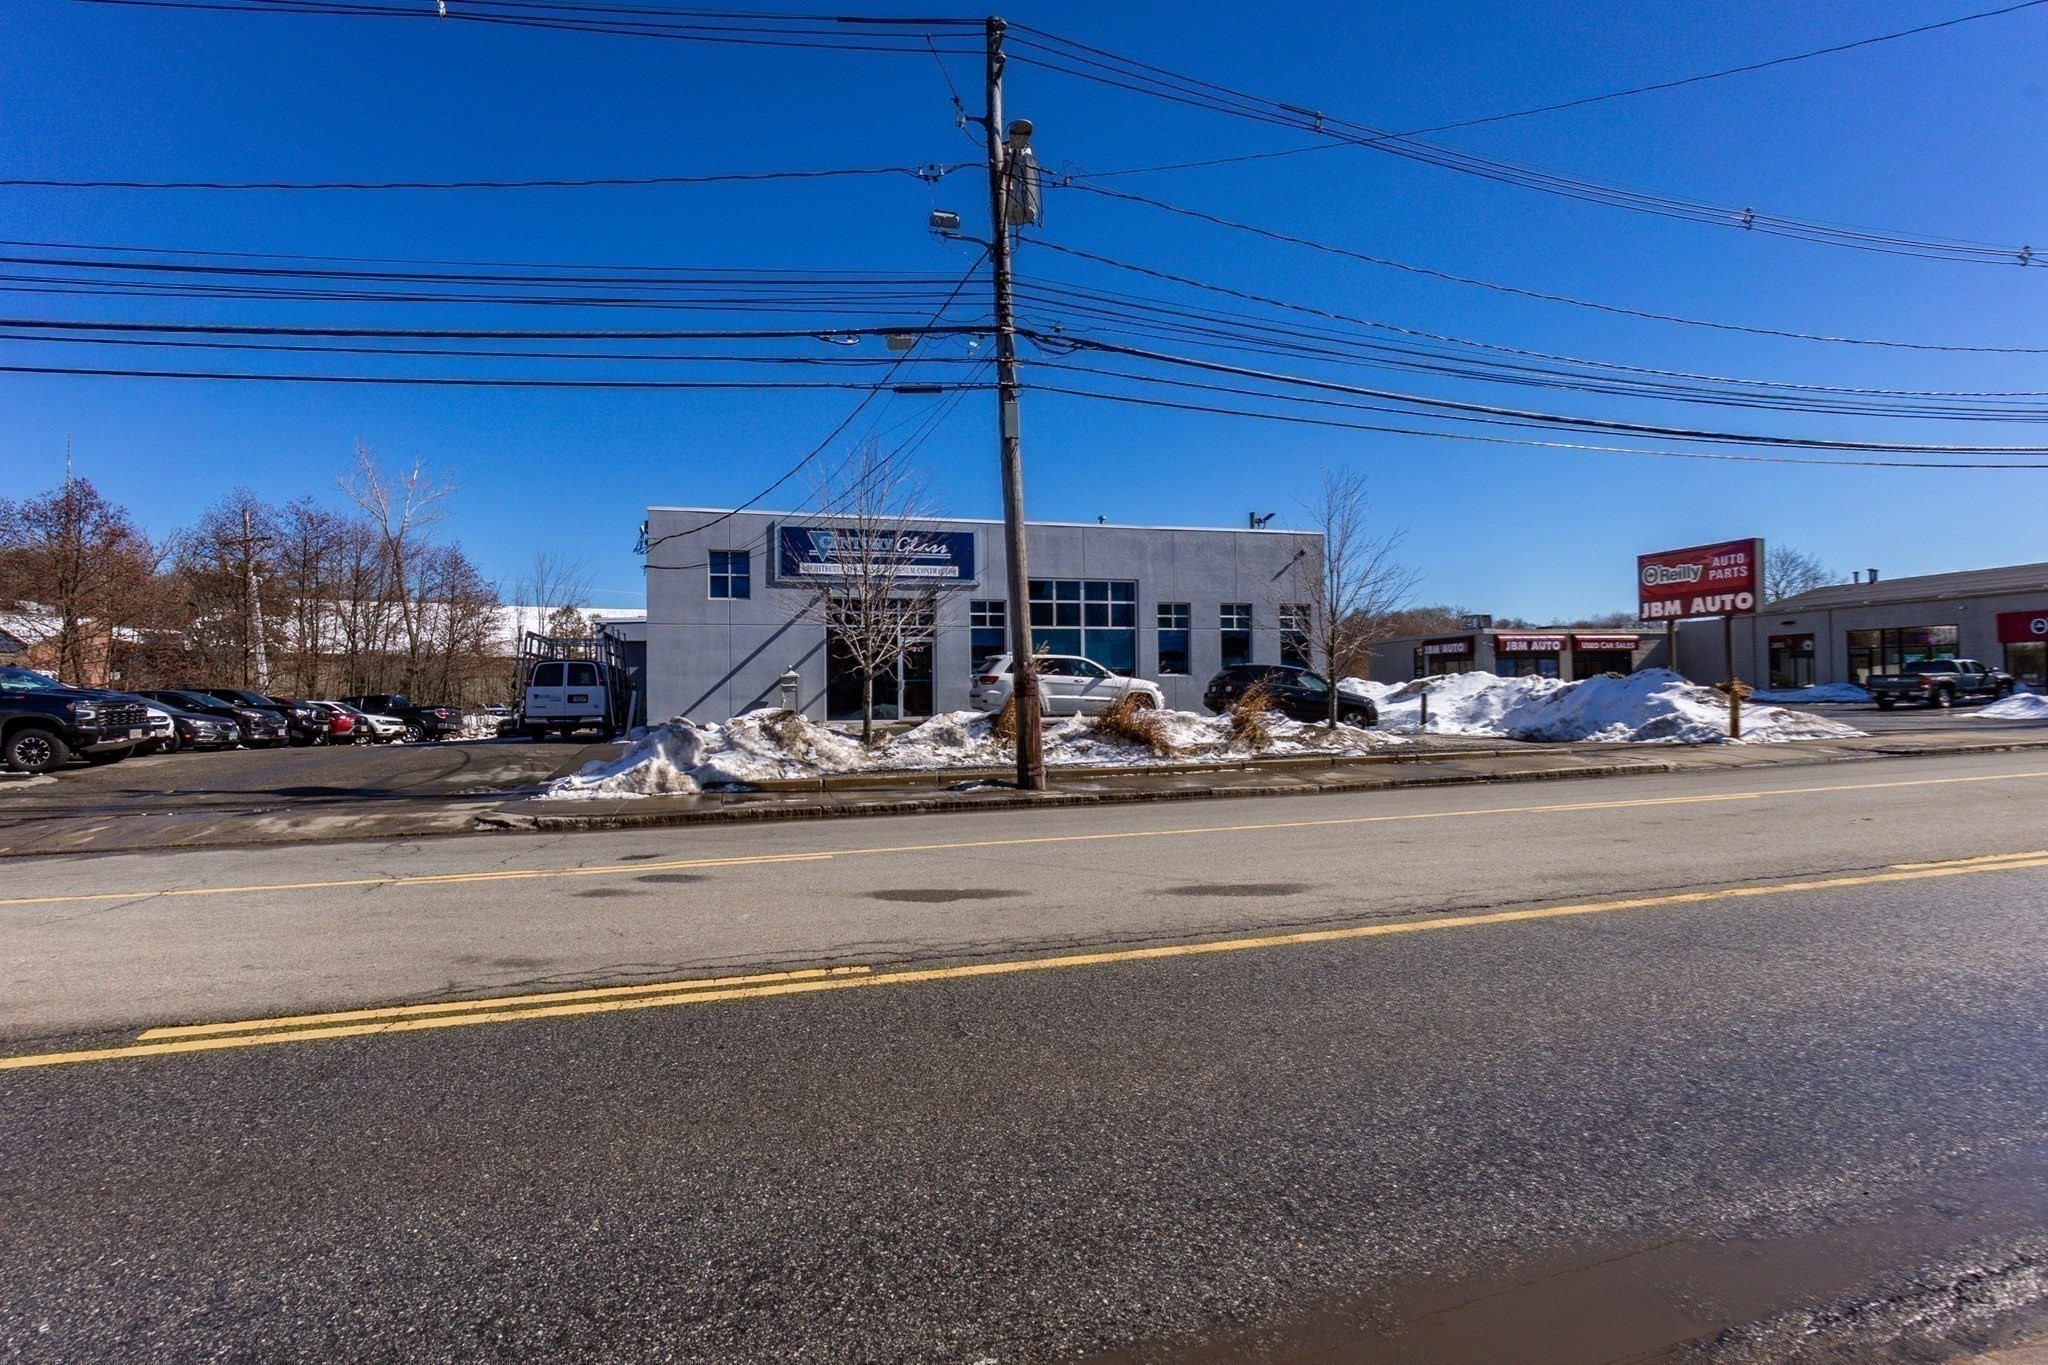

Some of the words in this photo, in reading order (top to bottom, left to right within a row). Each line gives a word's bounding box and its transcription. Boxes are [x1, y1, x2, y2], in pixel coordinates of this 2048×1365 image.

[896, 536, 948, 554] Glass
[1712, 553, 1744, 567] AUTO
[1641, 563, 1703, 586] O'Reilly
[1708, 566, 1748, 580] PARTS
[1641, 599, 1682, 619] JBM
[1690, 592, 1753, 614] AUTO
[1424, 645, 1440, 654] JBM
[1441, 642, 1464, 653] AUTO
[1505, 641, 1528, 651] JBM
[1530, 640, 1561, 651] AUTO
[1581, 641, 1599, 649] USED
[1600, 641, 1614, 649] CAR
[1615, 641, 1636, 649] SALES
